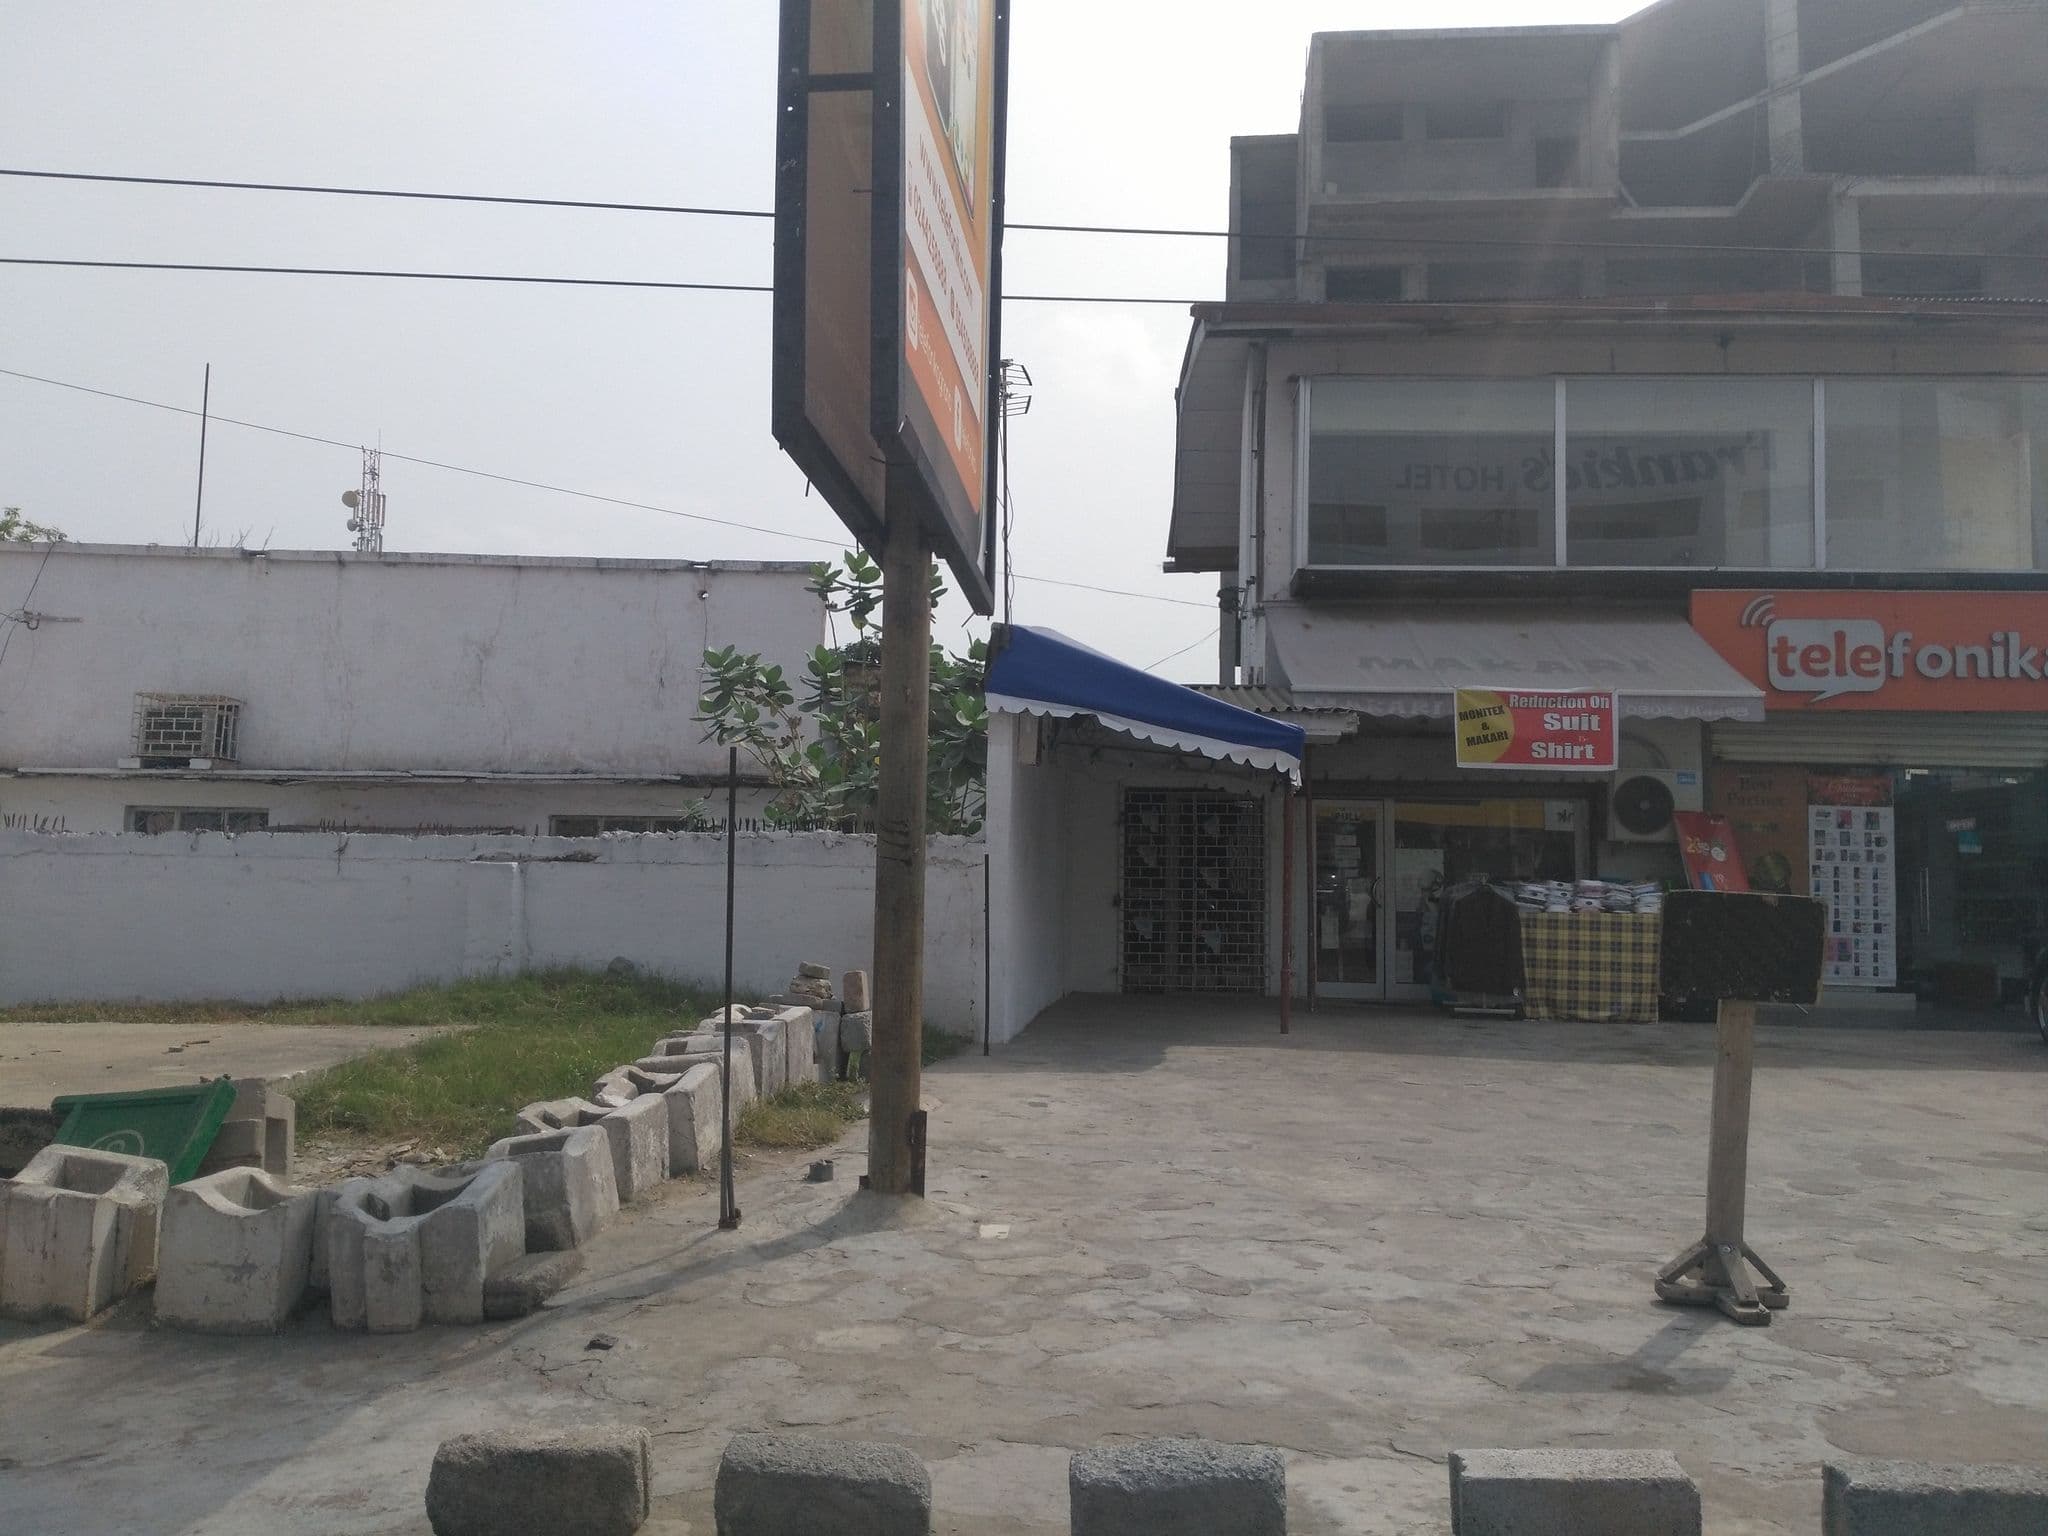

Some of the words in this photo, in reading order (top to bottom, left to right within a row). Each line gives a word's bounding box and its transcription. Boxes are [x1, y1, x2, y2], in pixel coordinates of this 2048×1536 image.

[1771, 630, 2048, 680] telefonik
[1509, 694, 1586, 709] Reduction
[1590, 695, 1610, 710] On
[1481, 722, 1490, 730] &
[1543, 712, 1601, 731] Suit
[1466, 731, 1509, 747] MAKARI
[1531, 741, 1595, 759] Shirt
